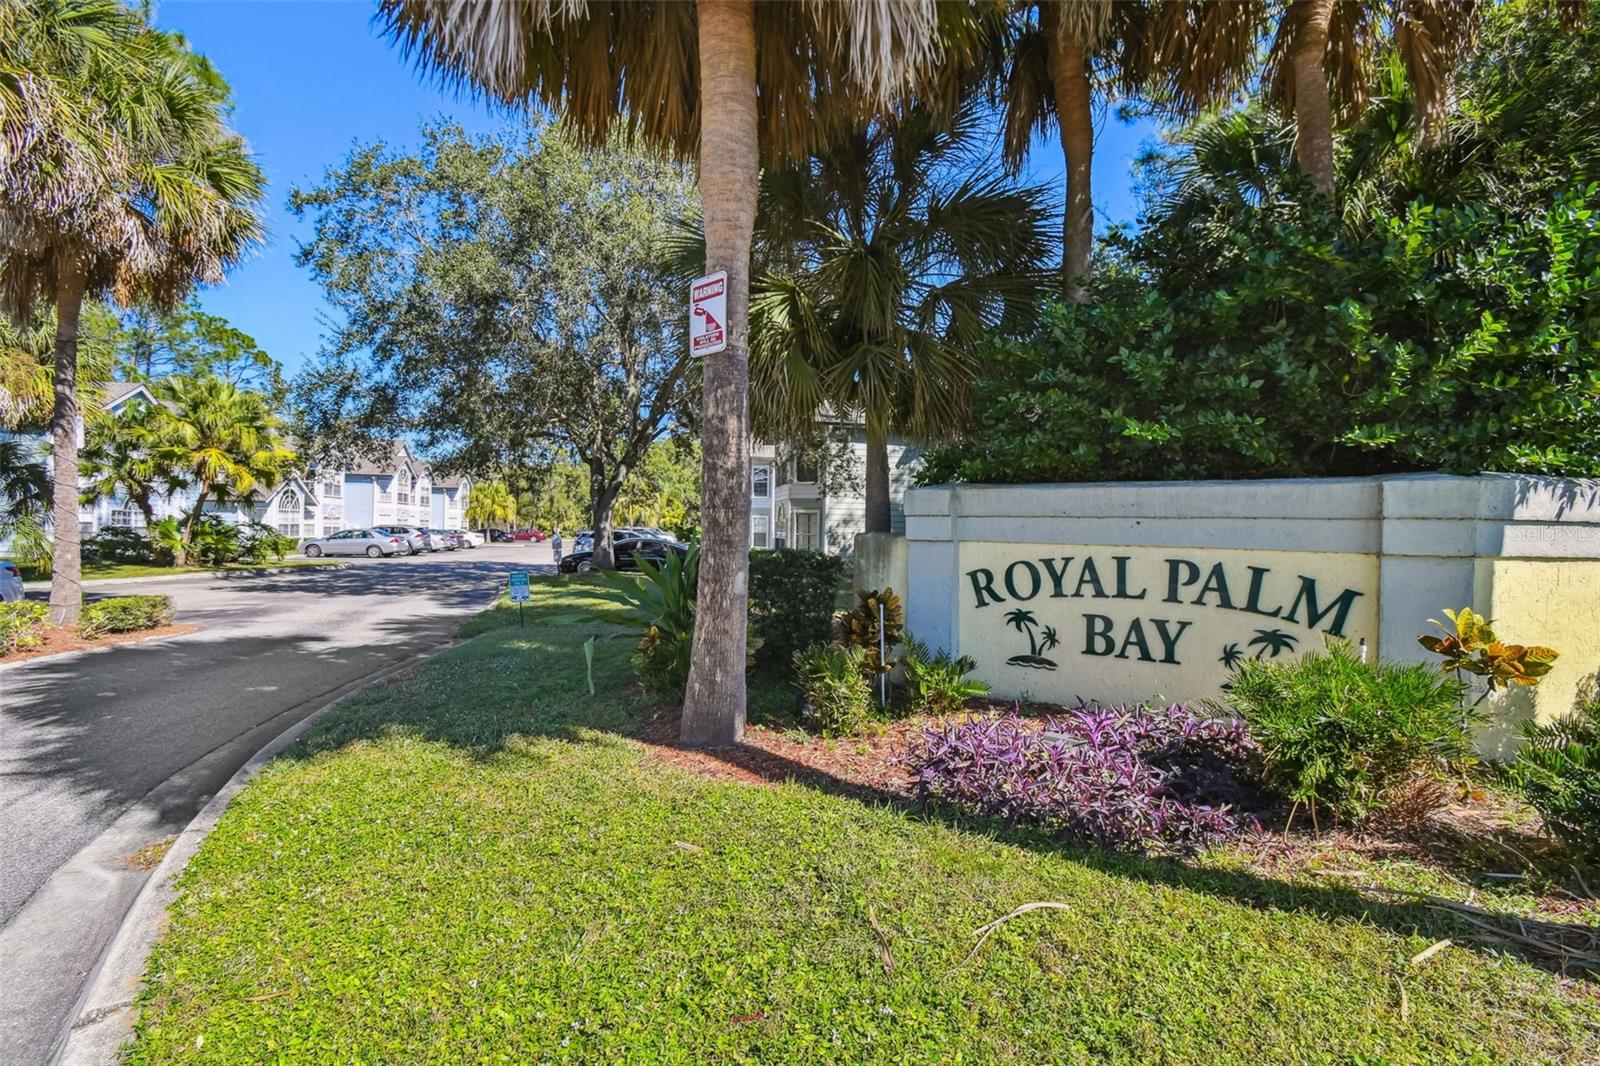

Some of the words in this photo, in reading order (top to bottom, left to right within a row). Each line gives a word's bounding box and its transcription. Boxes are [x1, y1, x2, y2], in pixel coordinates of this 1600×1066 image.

[694, 281, 723, 300] WARNING
[966, 555, 1147, 609] ROYAL
[1162, 558, 1364, 639] PALM
[1081, 613, 1193, 665] BAY
